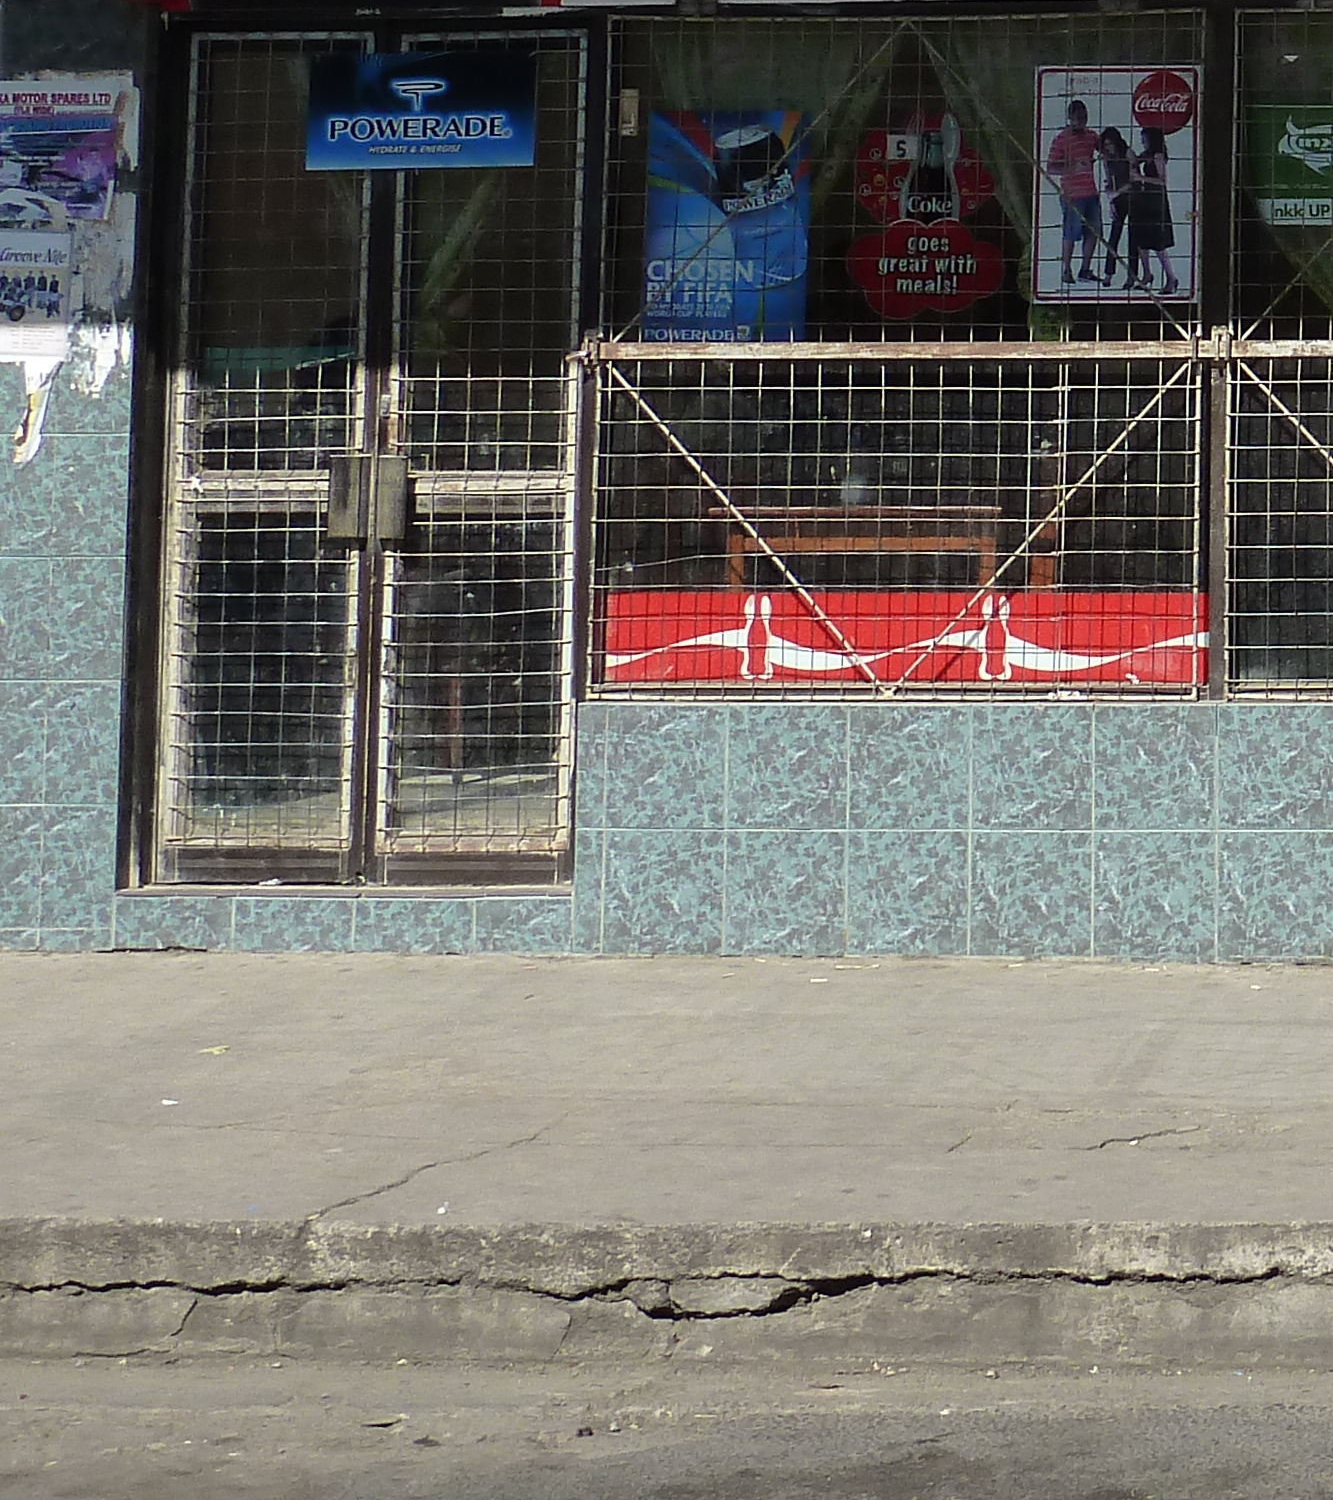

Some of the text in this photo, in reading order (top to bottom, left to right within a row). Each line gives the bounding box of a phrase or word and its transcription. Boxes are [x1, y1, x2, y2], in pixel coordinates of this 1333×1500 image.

[12, 93, 49, 105] MOTOR
[51, 93, 91, 105] SPARES
[328, 116, 504, 141] POWERADE
[908, 196, 952, 214] Coke
[1308, 204, 1330, 217] UP
[907, 236, 950, 255] goes
[646, 259, 755, 282] CHOSEN
[878, 253, 977, 276] great with
[646, 281, 733, 304] BY FIFA
[896, 275, 958, 295] meals!
